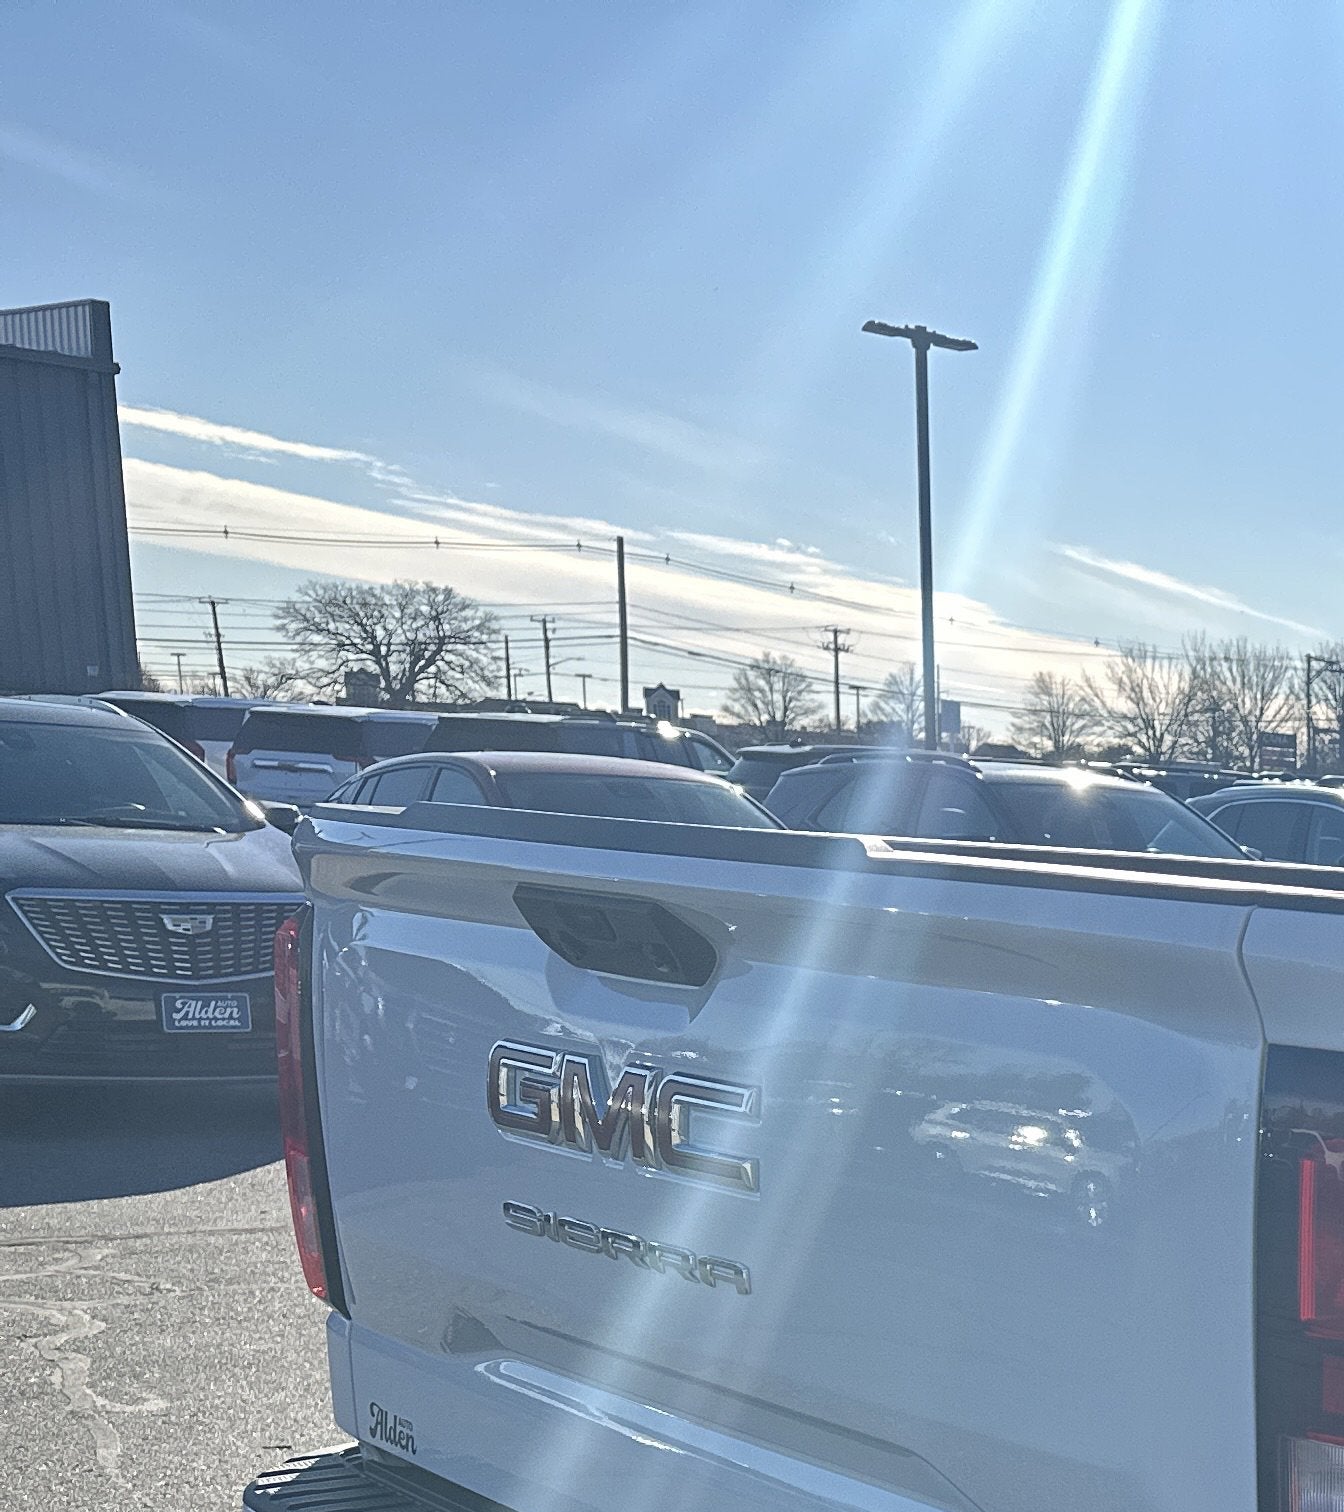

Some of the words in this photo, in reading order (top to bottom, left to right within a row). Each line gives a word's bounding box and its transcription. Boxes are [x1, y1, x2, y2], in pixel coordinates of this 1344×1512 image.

[172, 999, 241, 1019] Alden
[217, 1000, 238, 1008] AUTO
[174, 1019, 199, 1027] LOVE
[200, 1019, 210, 1027] IT
[211, 1019, 242, 1027] LOCAL
[486, 1039, 760, 1195] GMC
[503, 1200, 752, 1296] SIERRA
[369, 1401, 418, 1455] Alden
